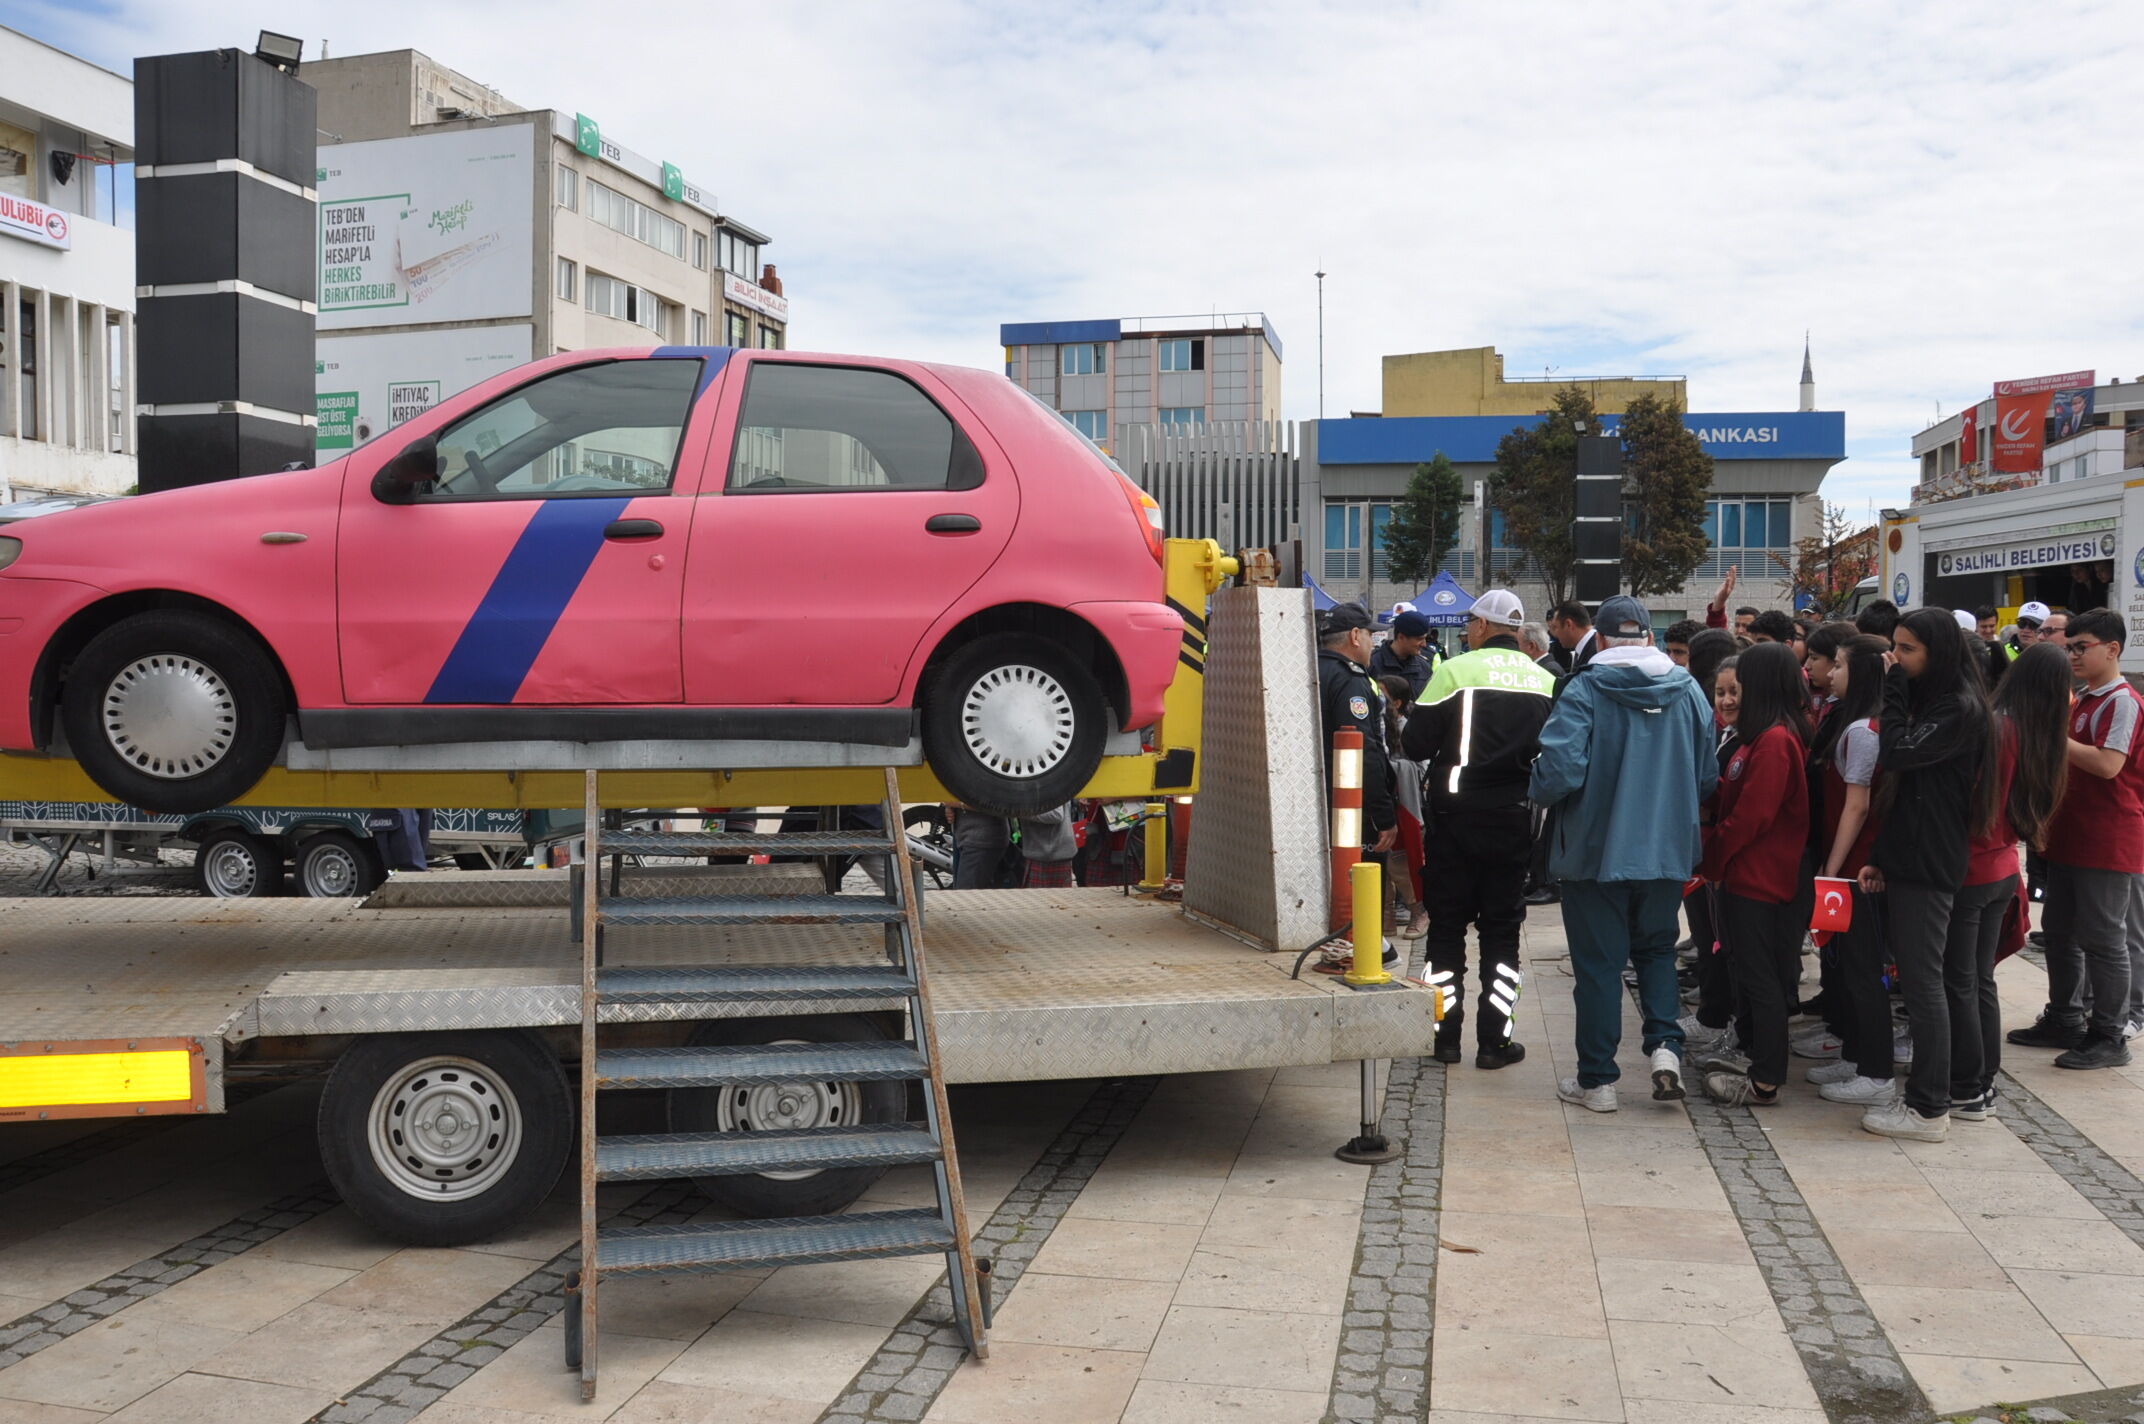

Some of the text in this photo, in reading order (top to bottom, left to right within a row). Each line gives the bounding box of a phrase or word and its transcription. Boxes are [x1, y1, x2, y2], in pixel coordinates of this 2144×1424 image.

[600, 140, 620, 161] TEB
[682, 184, 700, 203] TEB
[0, 196, 43, 227] ULÜBÜ
[325, 207, 365, 226] TEB'DEN
[325, 225, 375, 245] MARİFETLİ
[325, 245, 371, 265] HESAP'LA
[324, 266, 362, 284] HERKES
[324, 282, 396, 304] BİRİKTİREBİLİR
[317, 396, 356, 409] MASRAFLAR
[392, 386, 430, 404] İHTİYAÇ
[330, 409, 346, 423] ÜSTE
[1955, 538, 2097, 571] SALİHLİ BELEDİYESİ
[1429, 615, 1446, 624] İHLİ
[1488, 671, 1542, 689] POLİSİ
